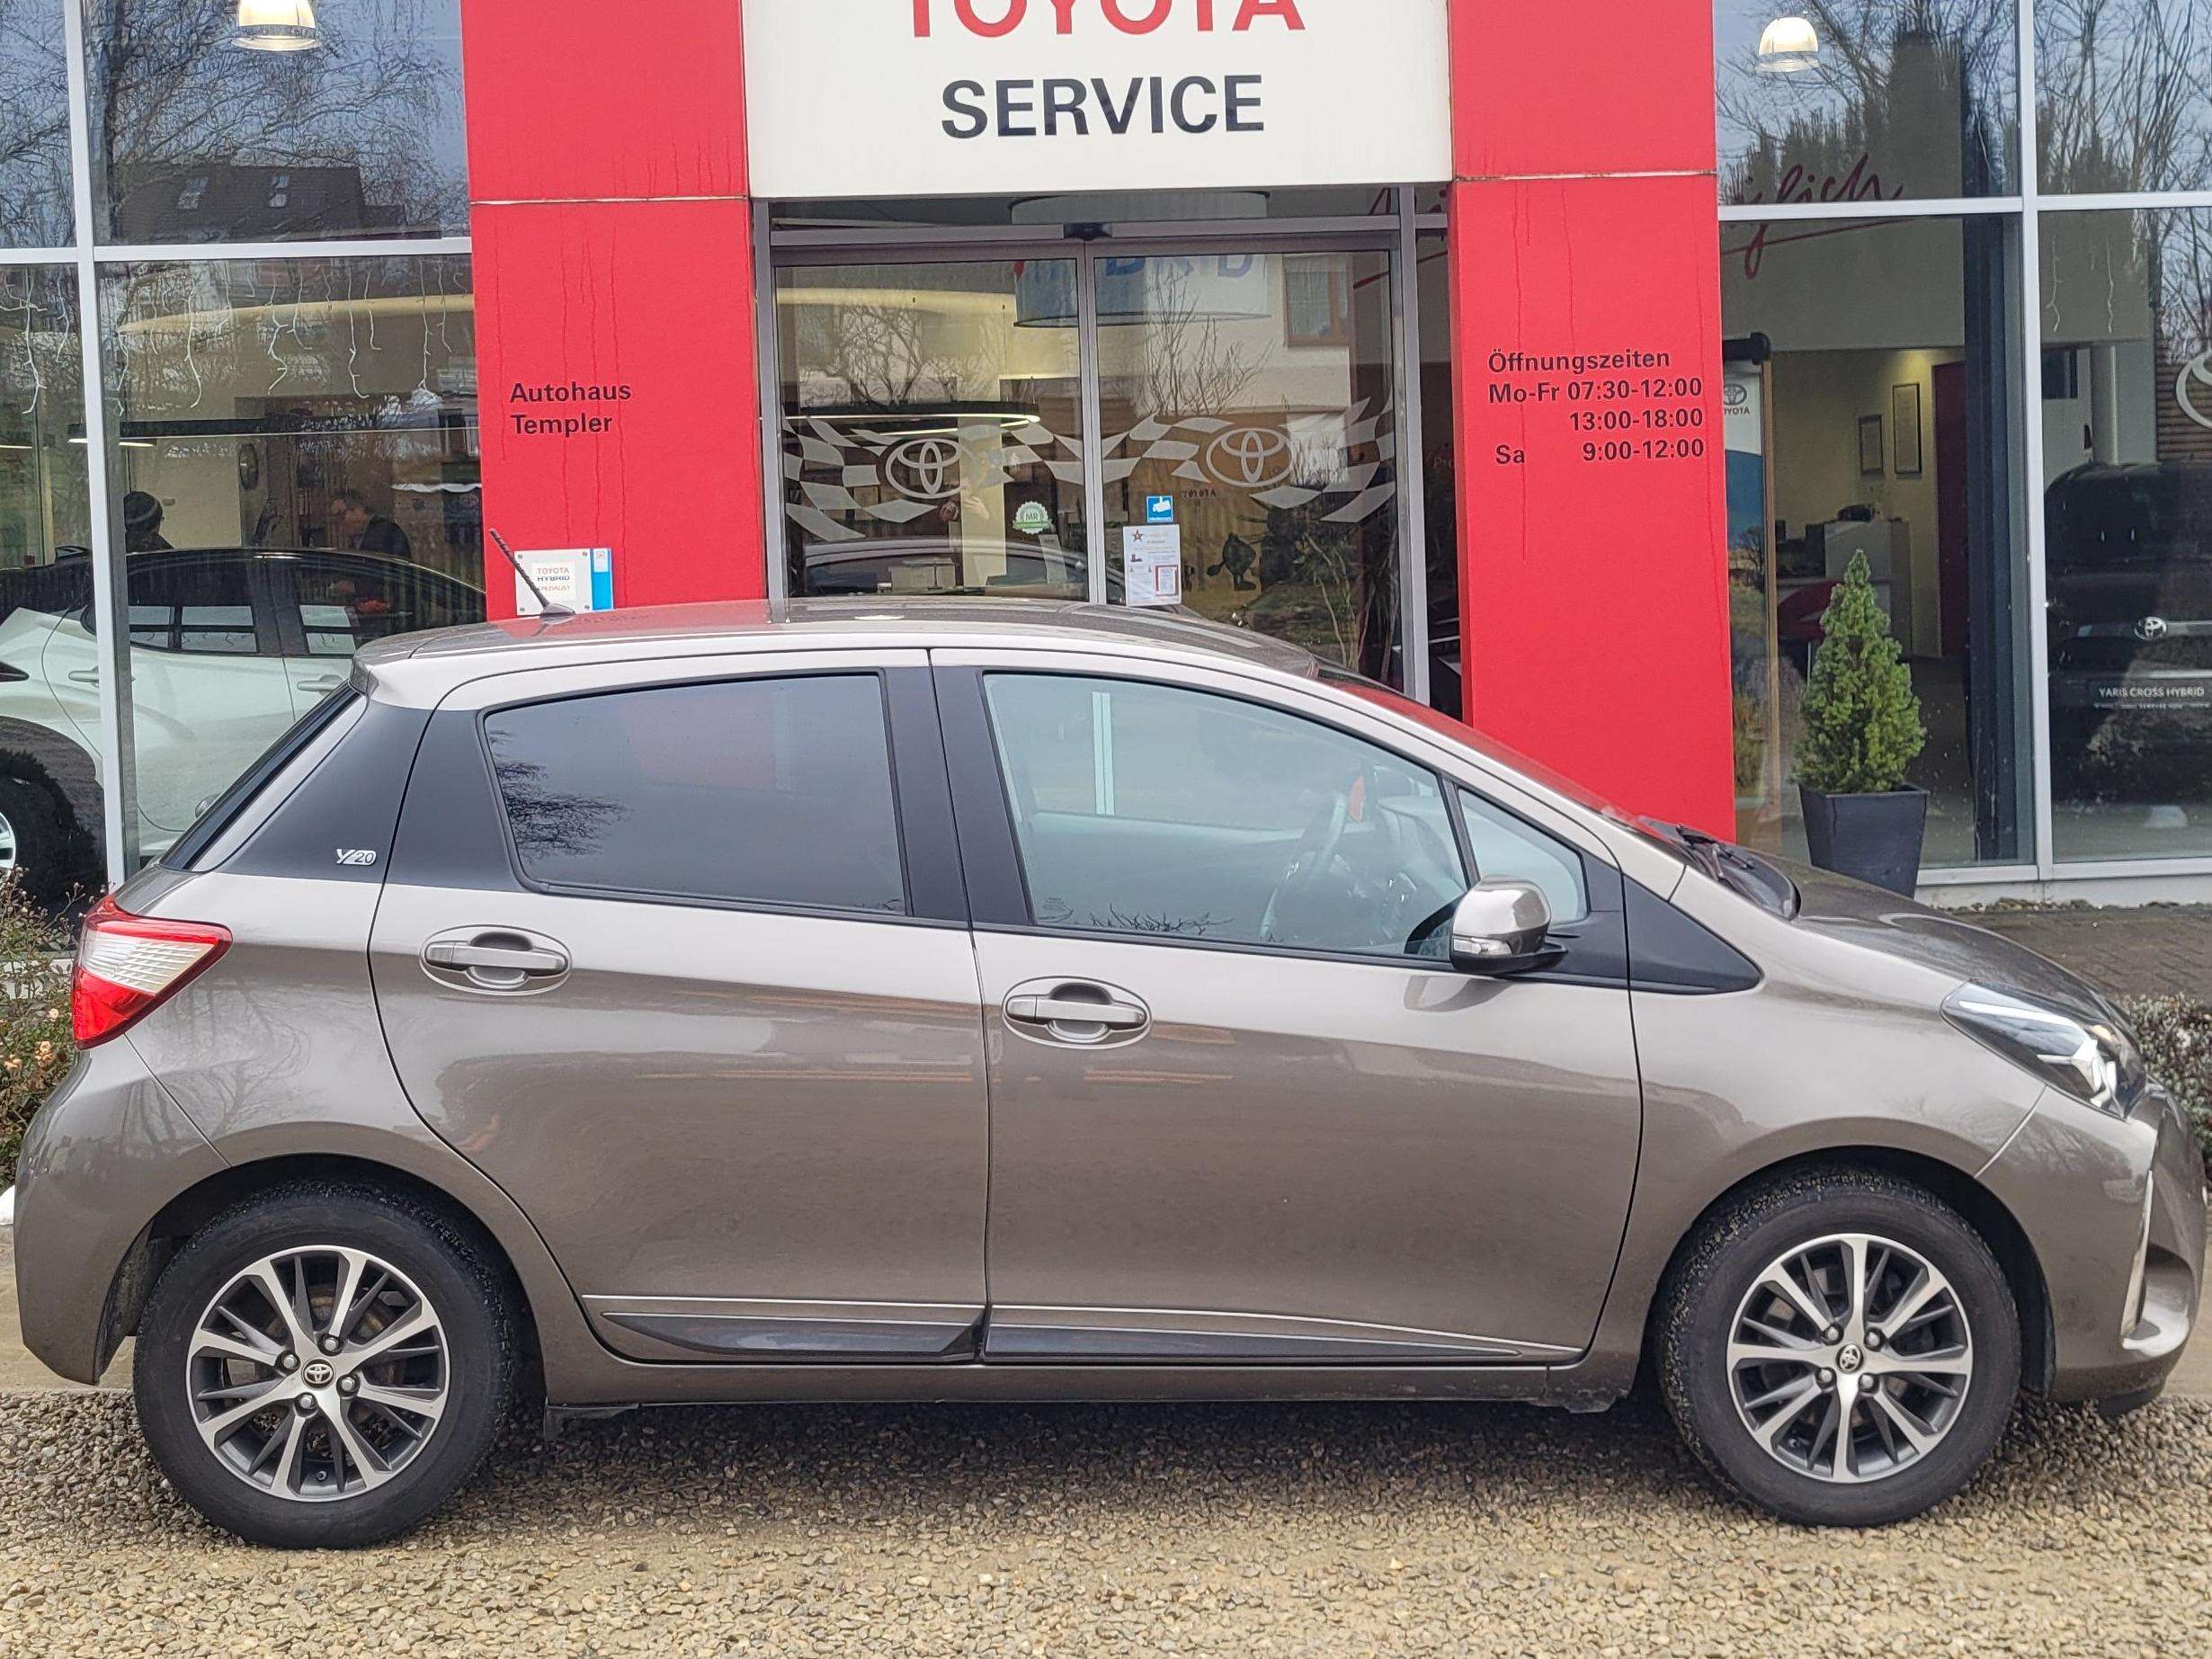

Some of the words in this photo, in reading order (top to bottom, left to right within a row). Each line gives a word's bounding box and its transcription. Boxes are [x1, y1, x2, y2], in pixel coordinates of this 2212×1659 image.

[941, 74, 1264, 139] SERVICE
[1488, 348, 1671, 374] Öffnungszeiten
[510, 381, 631, 403] Autohaus
[1489, 382, 1560, 404] Mo-Fr
[1566, 377, 1703, 400] 07:30-12:00
[510, 413, 613, 437] Templer
[1569, 408, 1704, 431] 13:00-18:00
[1495, 444, 1526, 464] Sa
[1582, 438, 1705, 461] 9:00-12:00
[2099, 687, 2128, 697] YARIS
[2129, 687, 2164, 697] CROSS
[2166, 686, 2205, 697] HYBRID
